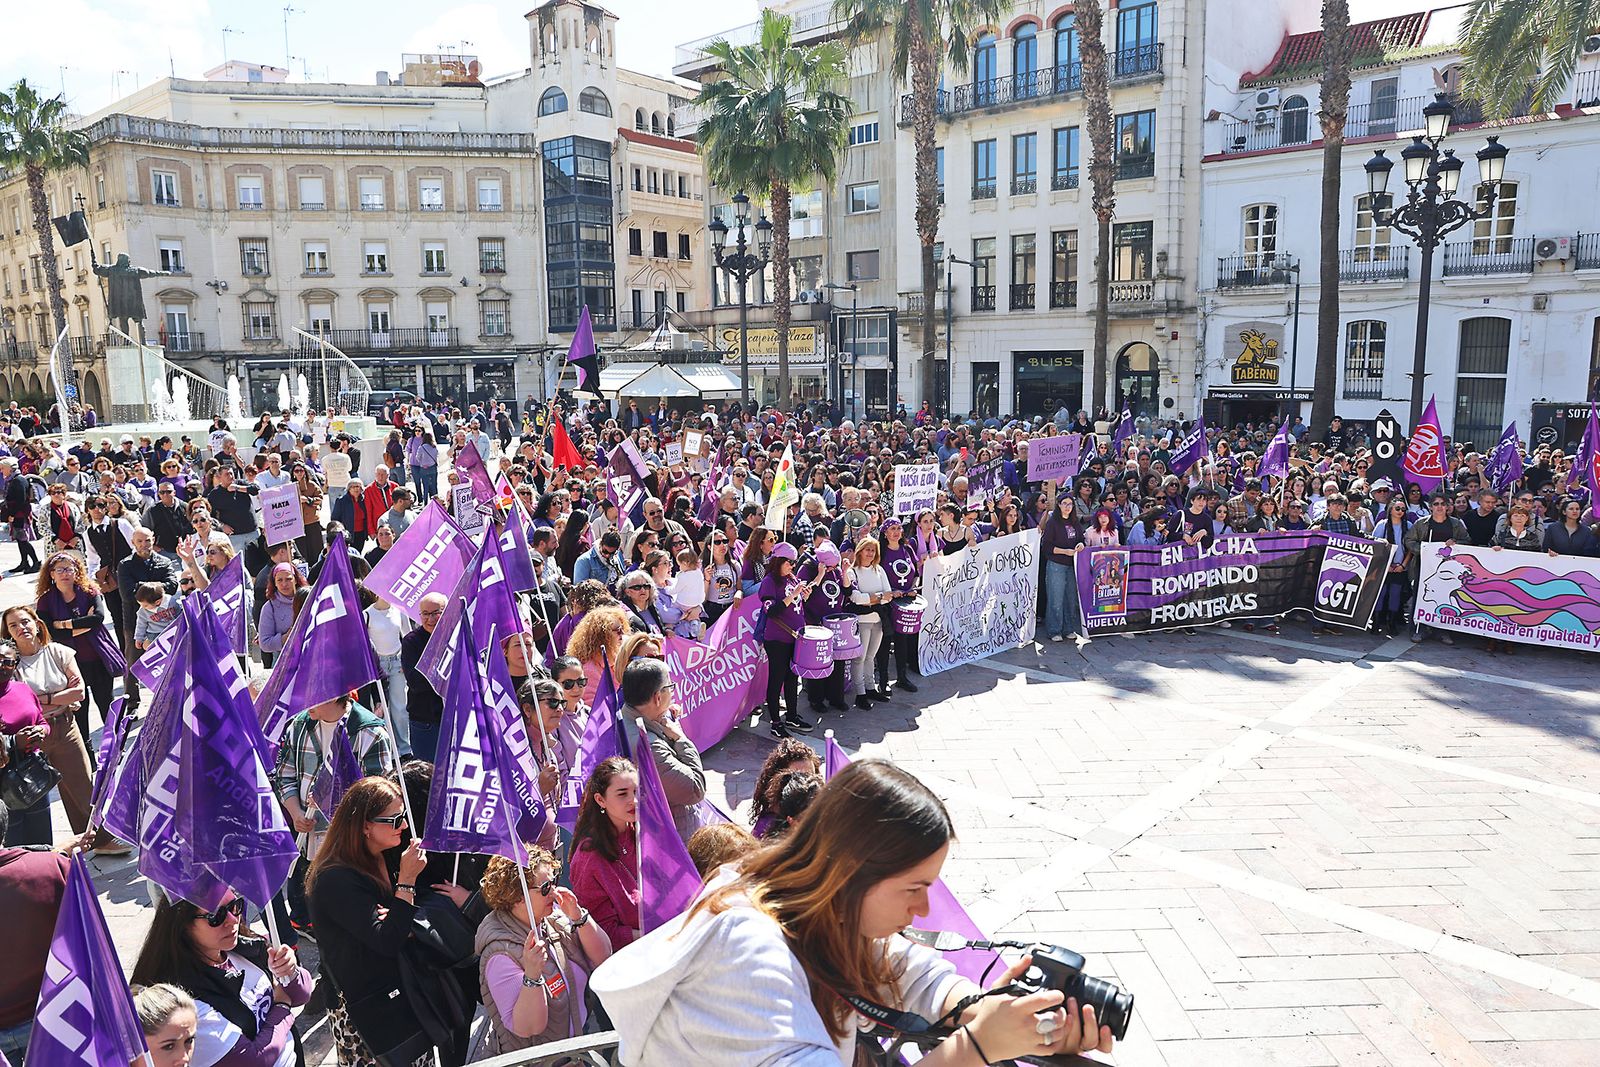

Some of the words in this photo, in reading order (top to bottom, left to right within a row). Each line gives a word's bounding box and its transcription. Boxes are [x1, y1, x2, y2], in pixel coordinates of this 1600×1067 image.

[1028, 357, 1073, 367] BLISS
[1376, 420, 1395, 459] NO
[1161, 545, 1184, 566] EN
[1197, 536, 1259, 560] LCHA
[1328, 536, 1374, 555] HUELVA
[1150, 593, 1258, 624] FRONTERAS
[1318, 580, 1359, 610] CGT
[1087, 617, 1127, 628] HUELVA
[1417, 608, 1438, 623] Por
[1440, 614, 1461, 626] una
[1463, 616, 1518, 637] sociedad
[1518, 626, 1534, 638] en
[1536, 626, 1592, 645] igualdad
[711, 664, 757, 697] MUND
[850, 998, 888, 1018] anon
